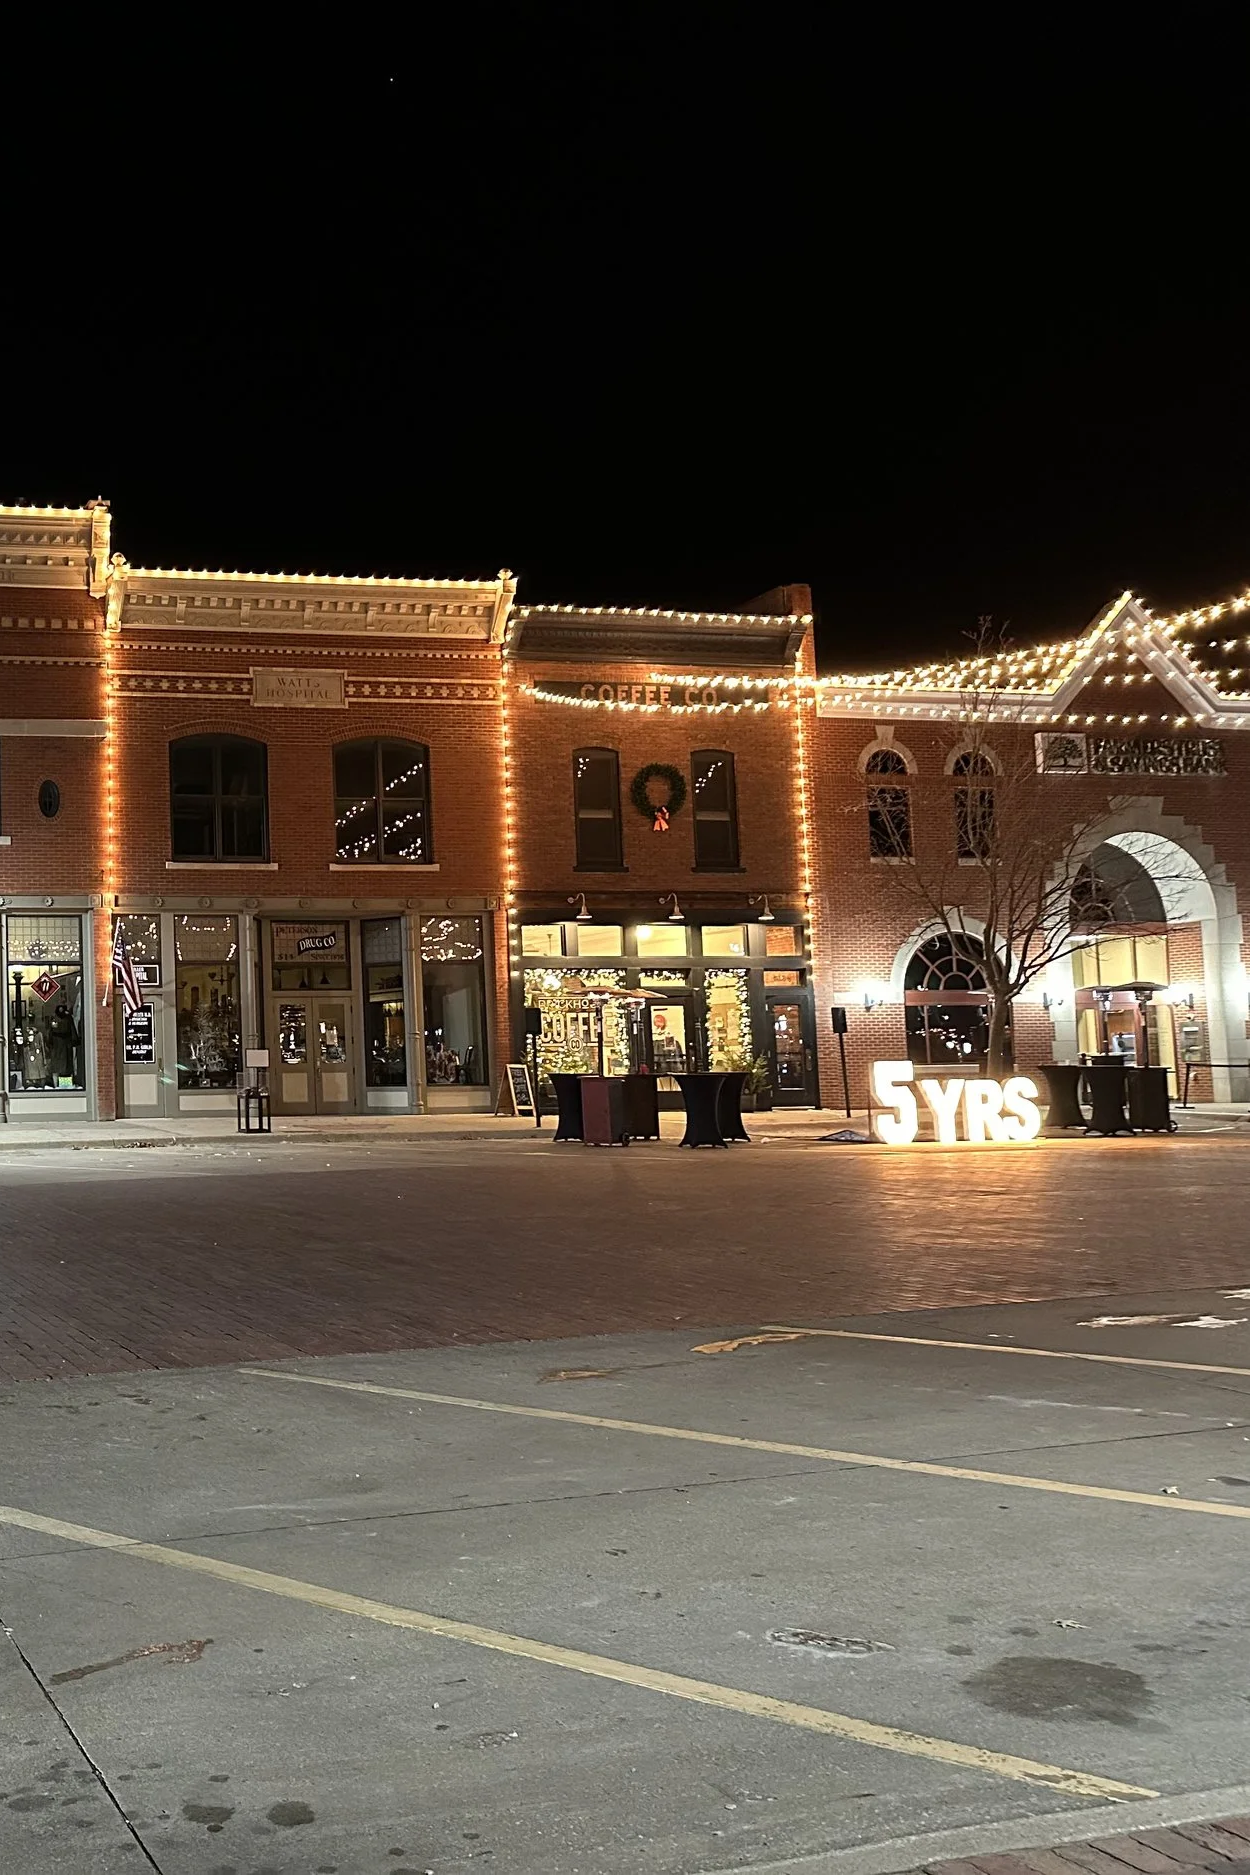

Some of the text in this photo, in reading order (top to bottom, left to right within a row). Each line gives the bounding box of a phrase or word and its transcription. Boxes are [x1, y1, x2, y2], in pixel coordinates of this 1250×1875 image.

[277, 677, 320, 688] WATTS
[266, 688, 332, 700] HOSPITAL
[580, 683, 718, 707] COFFEE CO
[275, 926, 318, 937] PETERSON
[299, 938, 323, 951] DRUG
[541, 1012, 615, 1043] COFFEE
[871, 1060, 1042, 1145] 5 YRS
